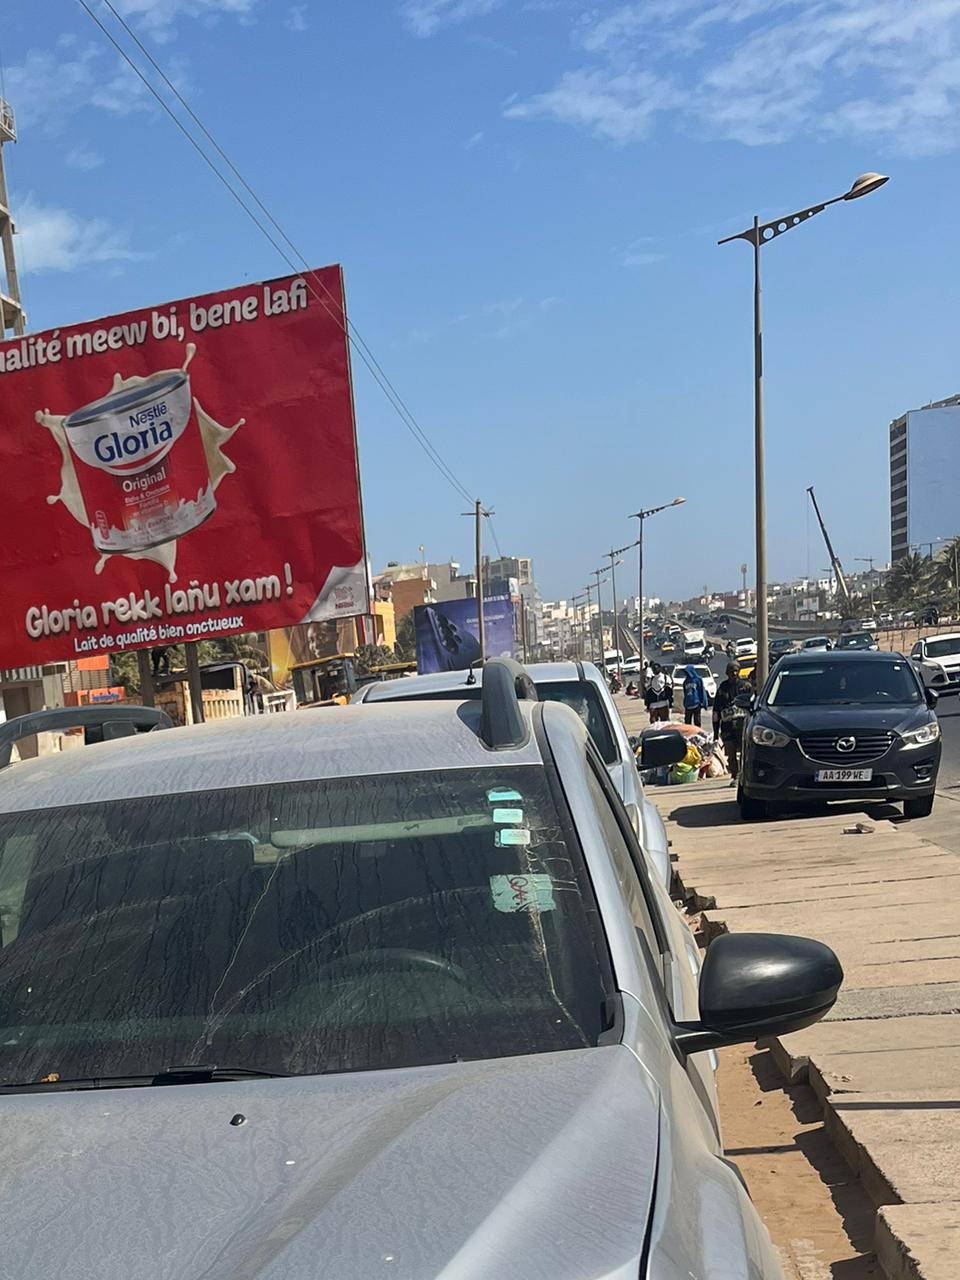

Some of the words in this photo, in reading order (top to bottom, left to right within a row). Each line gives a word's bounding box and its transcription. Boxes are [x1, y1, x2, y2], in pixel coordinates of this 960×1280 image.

[66, 320, 147, 359] meew
[151, 306, 185, 342] bi,
[190, 296, 258, 332] bene
[263, 278, 307, 317] lafi
[129, 401, 167, 428] Nestlé
[93, 421, 173, 463] Gloria
[122, 466, 167, 493] Original
[25, 598, 98, 639] Gloria
[101, 589, 163, 625] rekk
[164, 579, 220, 615] lañu
[224, 574, 281, 604] xam
[73, 636, 99, 653] Lait
[99, 633, 115, 649] de
[116, 624, 158, 650] qualité
[158, 624, 185, 641] bien
[186, 615, 244, 635] onctueux
